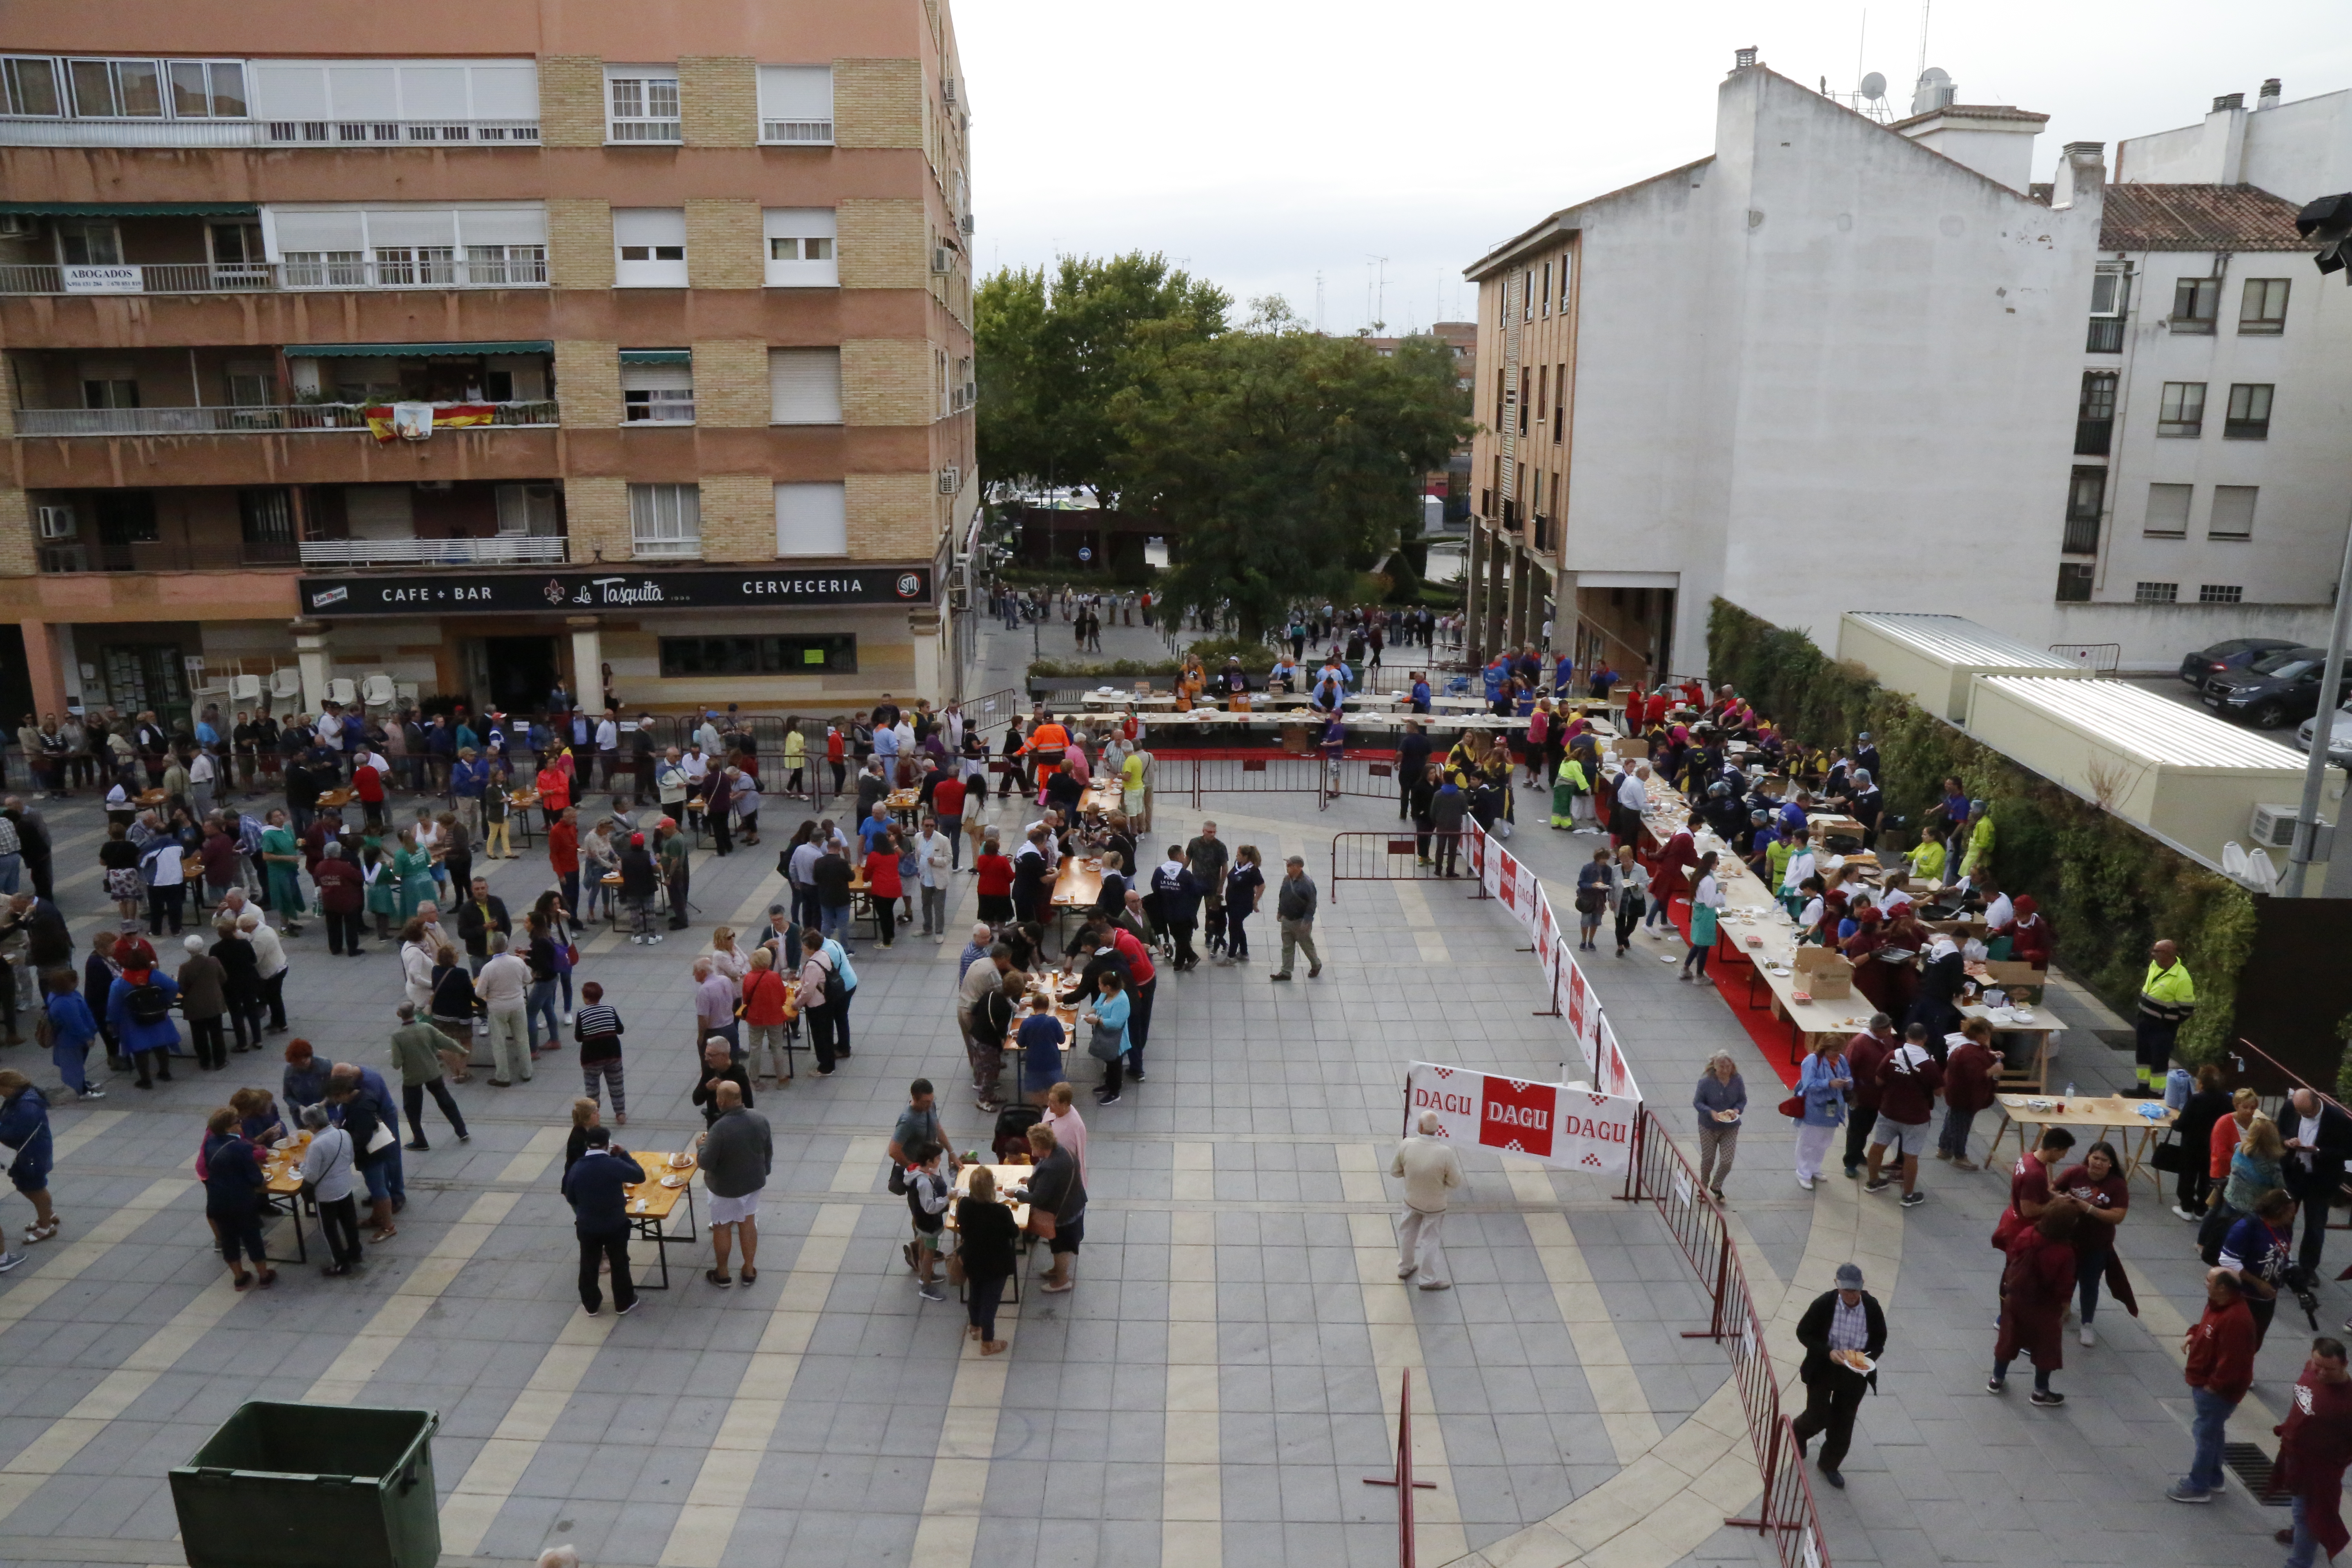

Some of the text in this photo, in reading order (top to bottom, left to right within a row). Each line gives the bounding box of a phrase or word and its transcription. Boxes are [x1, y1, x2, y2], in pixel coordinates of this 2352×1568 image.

[71, 270, 132, 278] ABOGADOS
[382, 587, 492, 602] CAFE BAR
[572, 586, 592, 604] La
[592, 577, 664, 605] Tasquita
[742, 579, 862, 594] CERVECERIA
[1414, 1088, 1472, 1116] DAGU
[1487, 1101, 1548, 1131] DAGU
[1564, 1115, 1626, 1144] DAGU
